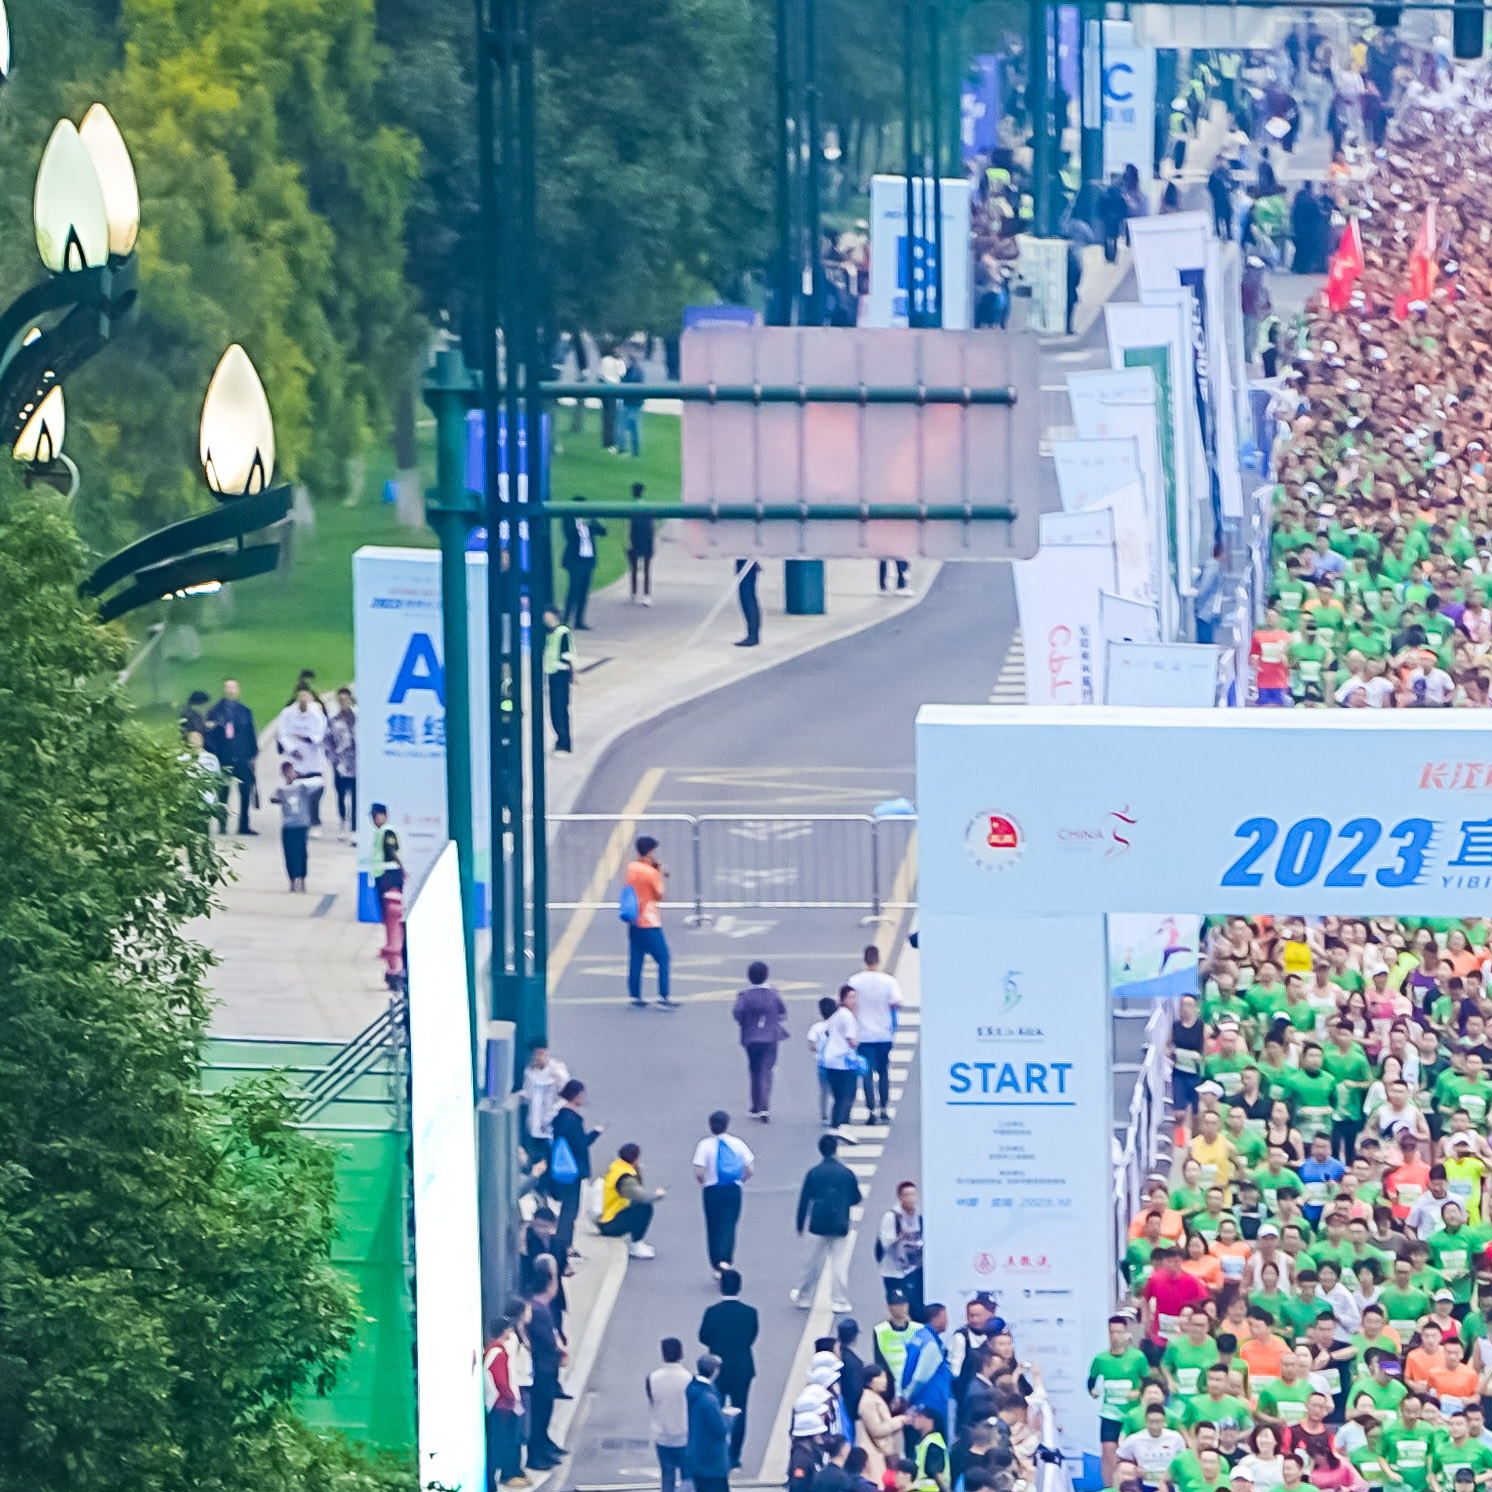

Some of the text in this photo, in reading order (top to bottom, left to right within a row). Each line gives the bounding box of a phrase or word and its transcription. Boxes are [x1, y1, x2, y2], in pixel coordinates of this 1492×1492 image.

[388, 632, 446, 706] A
[1221, 816, 1438, 888] 2023
[949, 1061, 1074, 1094] START
